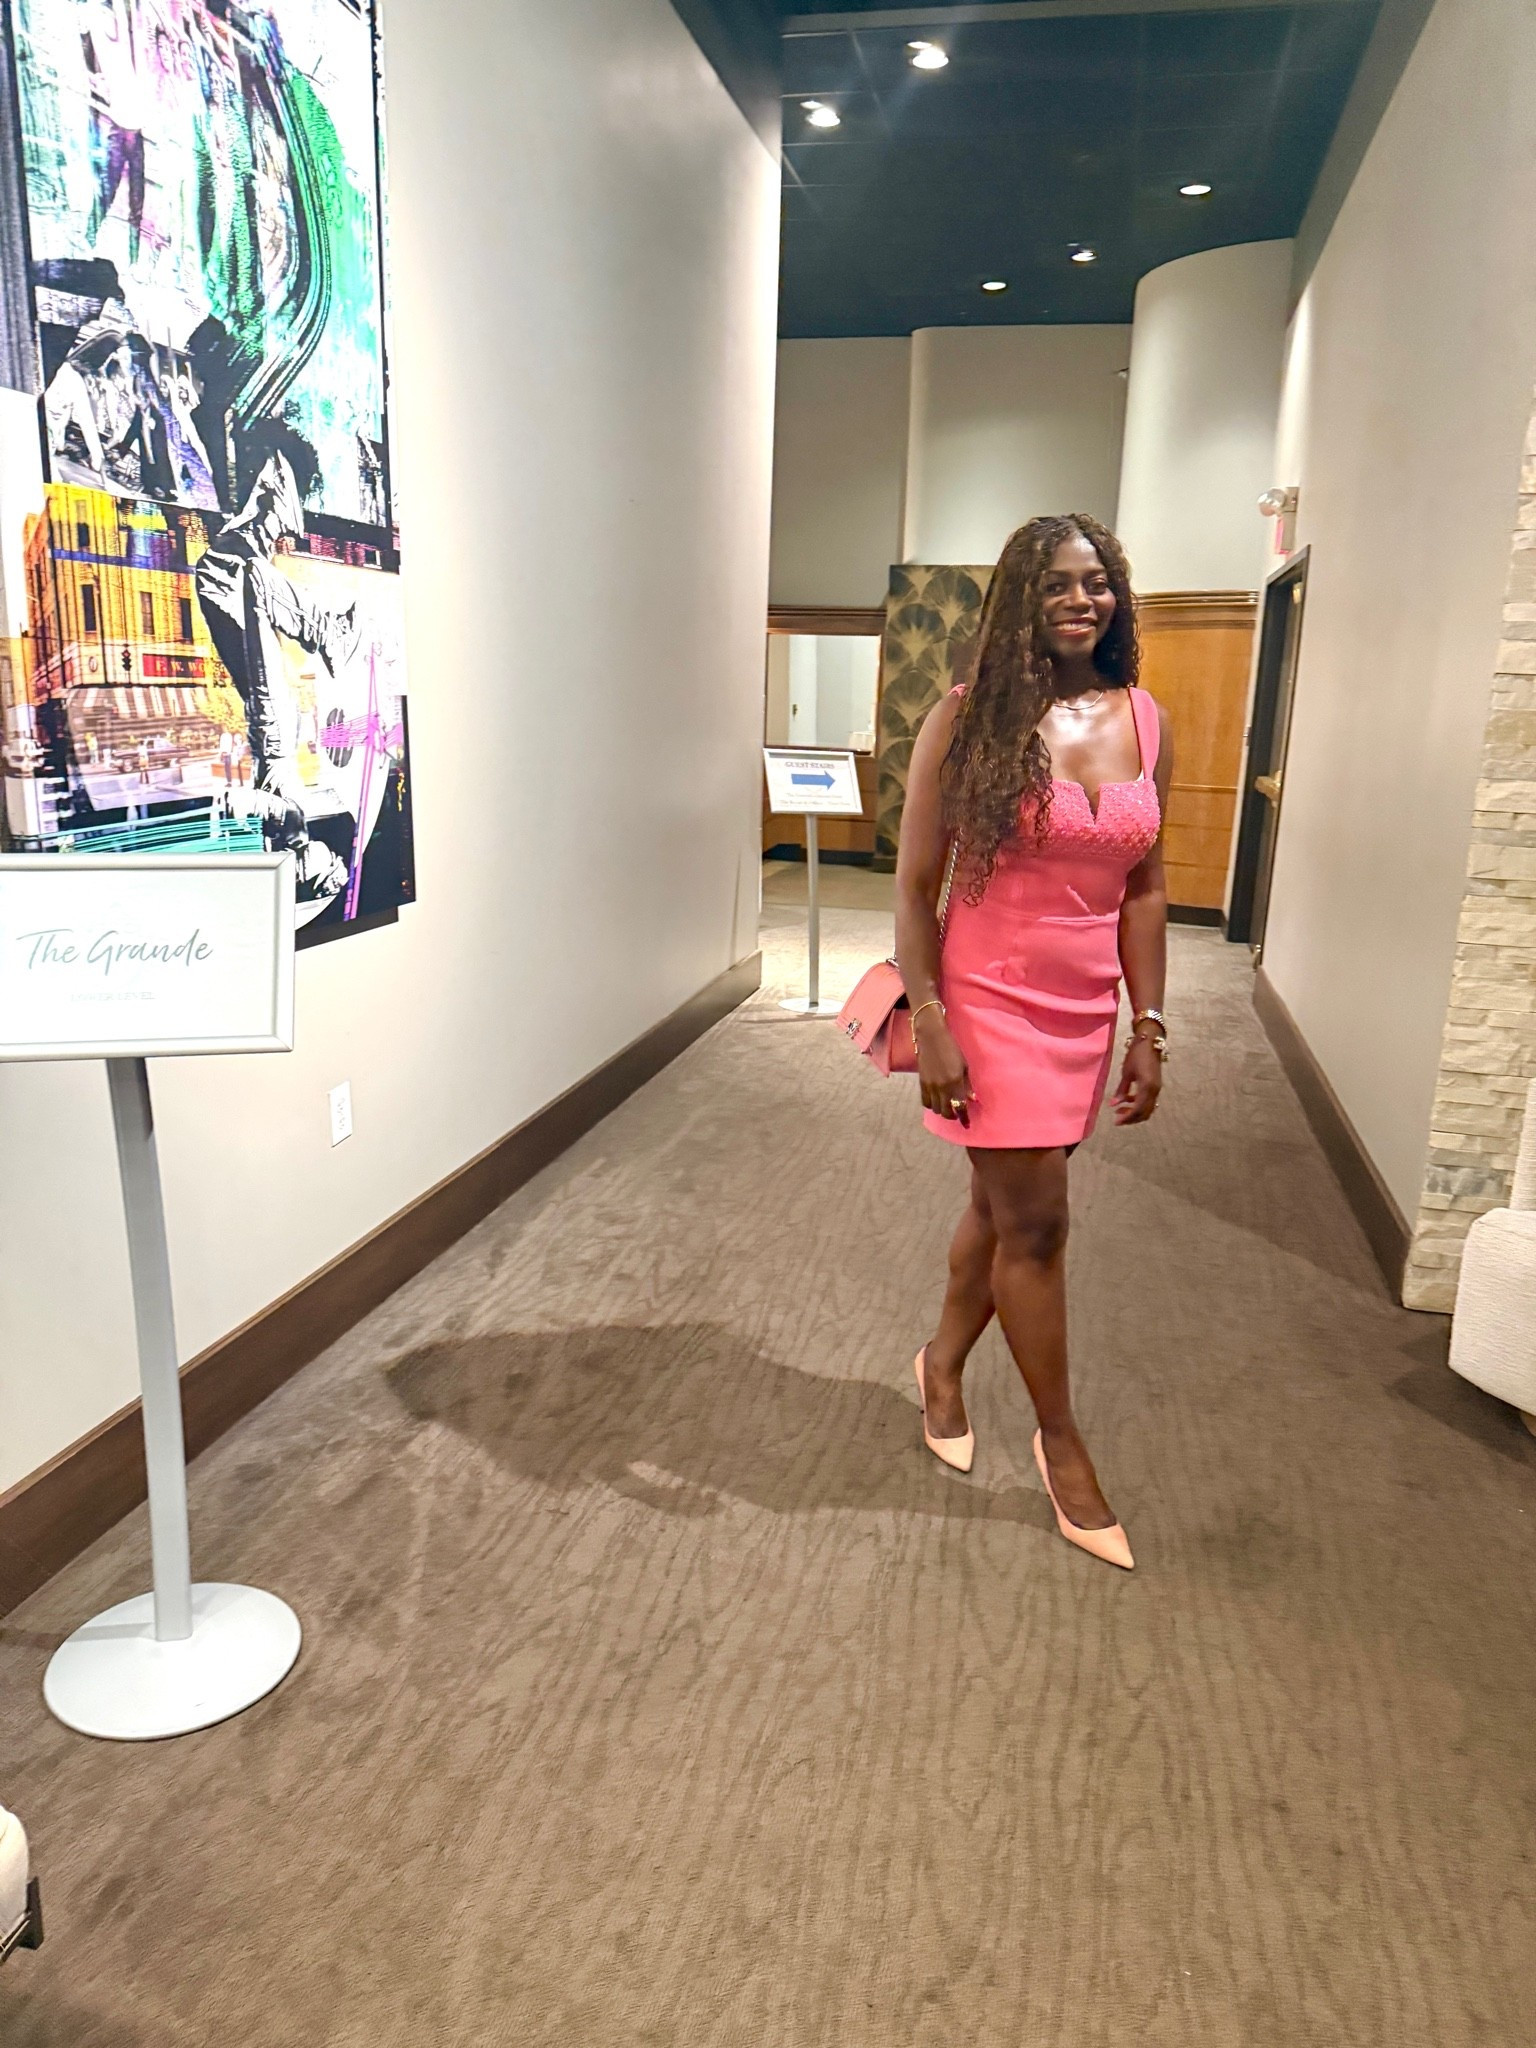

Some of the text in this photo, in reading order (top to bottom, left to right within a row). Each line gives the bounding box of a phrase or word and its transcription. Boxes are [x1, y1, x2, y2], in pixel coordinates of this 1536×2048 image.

[16, 928, 213, 976] The Grande
[70, 991, 156, 1001] LOWER LEVEL
